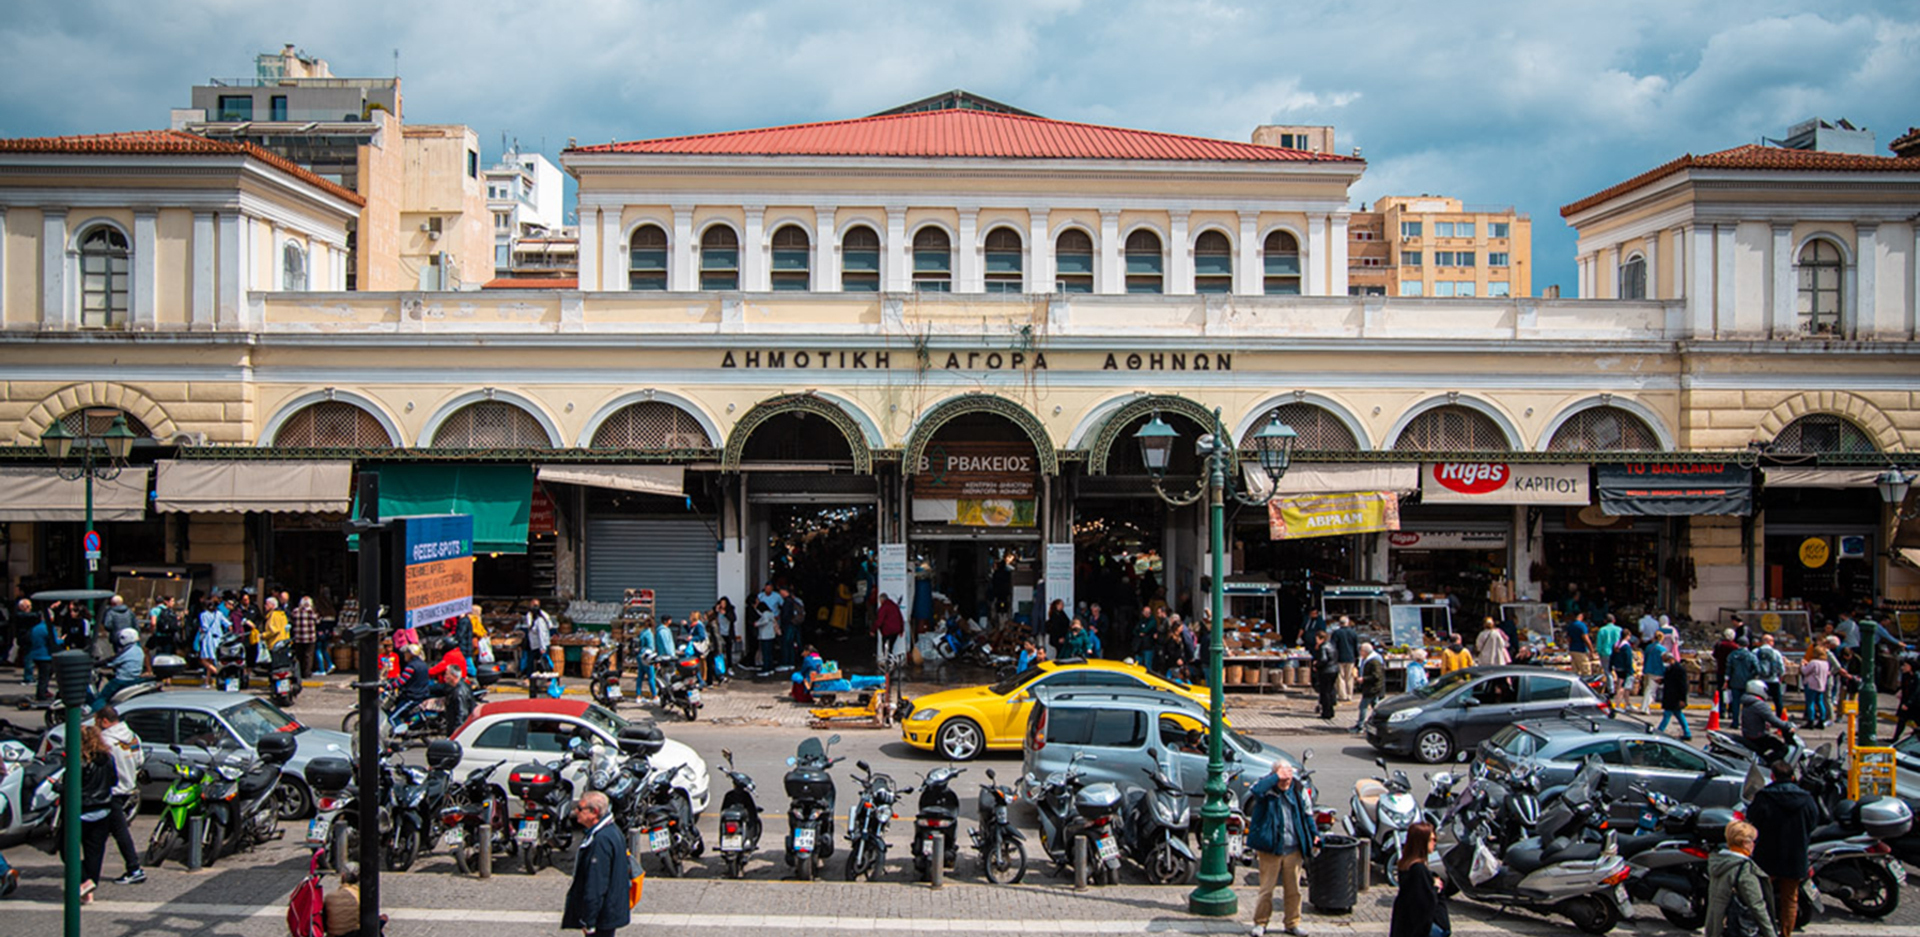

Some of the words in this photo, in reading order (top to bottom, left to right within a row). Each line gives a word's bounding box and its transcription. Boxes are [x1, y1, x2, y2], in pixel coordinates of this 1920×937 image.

[721, 351, 890, 369] ΔΗΜΟΤΙΚΗ
[945, 352, 1049, 370] ΑΓΟΡΑ
[1102, 352, 1232, 371] ΑΘΗΝΩΝ
[1440, 463, 1504, 486] Rigas
[1514, 476, 1577, 494] ΚΑΡΠΟΙ
[1306, 512, 1363, 529] ΑΒΡΑΑΜ
